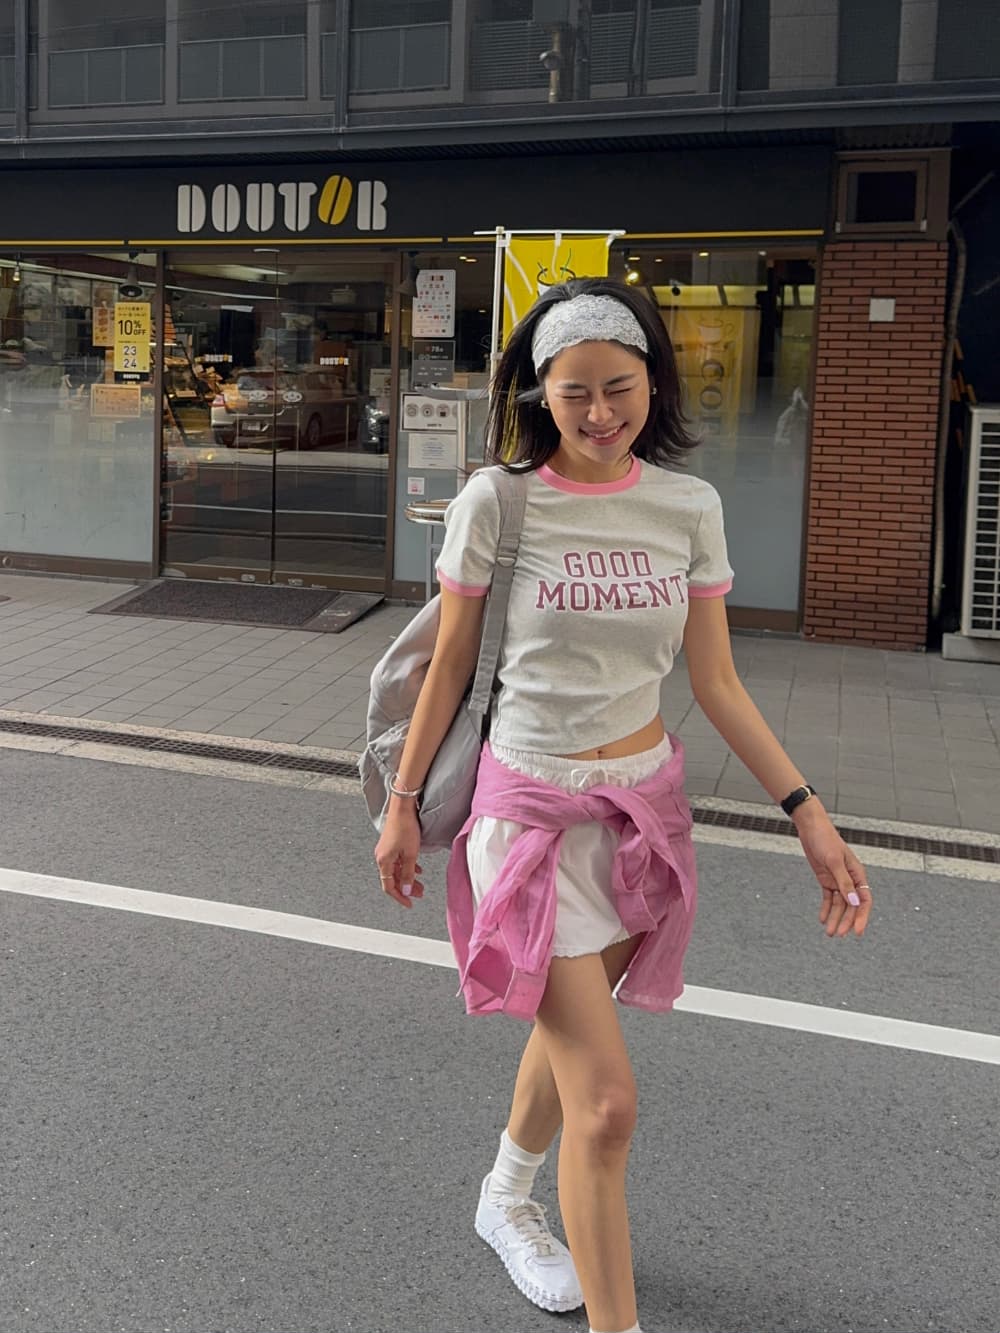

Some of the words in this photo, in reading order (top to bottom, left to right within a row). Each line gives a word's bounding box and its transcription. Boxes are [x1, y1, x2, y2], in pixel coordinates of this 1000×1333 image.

[177, 175, 388, 232] DOUTOR
[123, 346, 137, 355] 23
[123, 359, 137, 368] 24
[562, 550, 653, 578] GOOD
[534, 574, 686, 612] MOMENT
